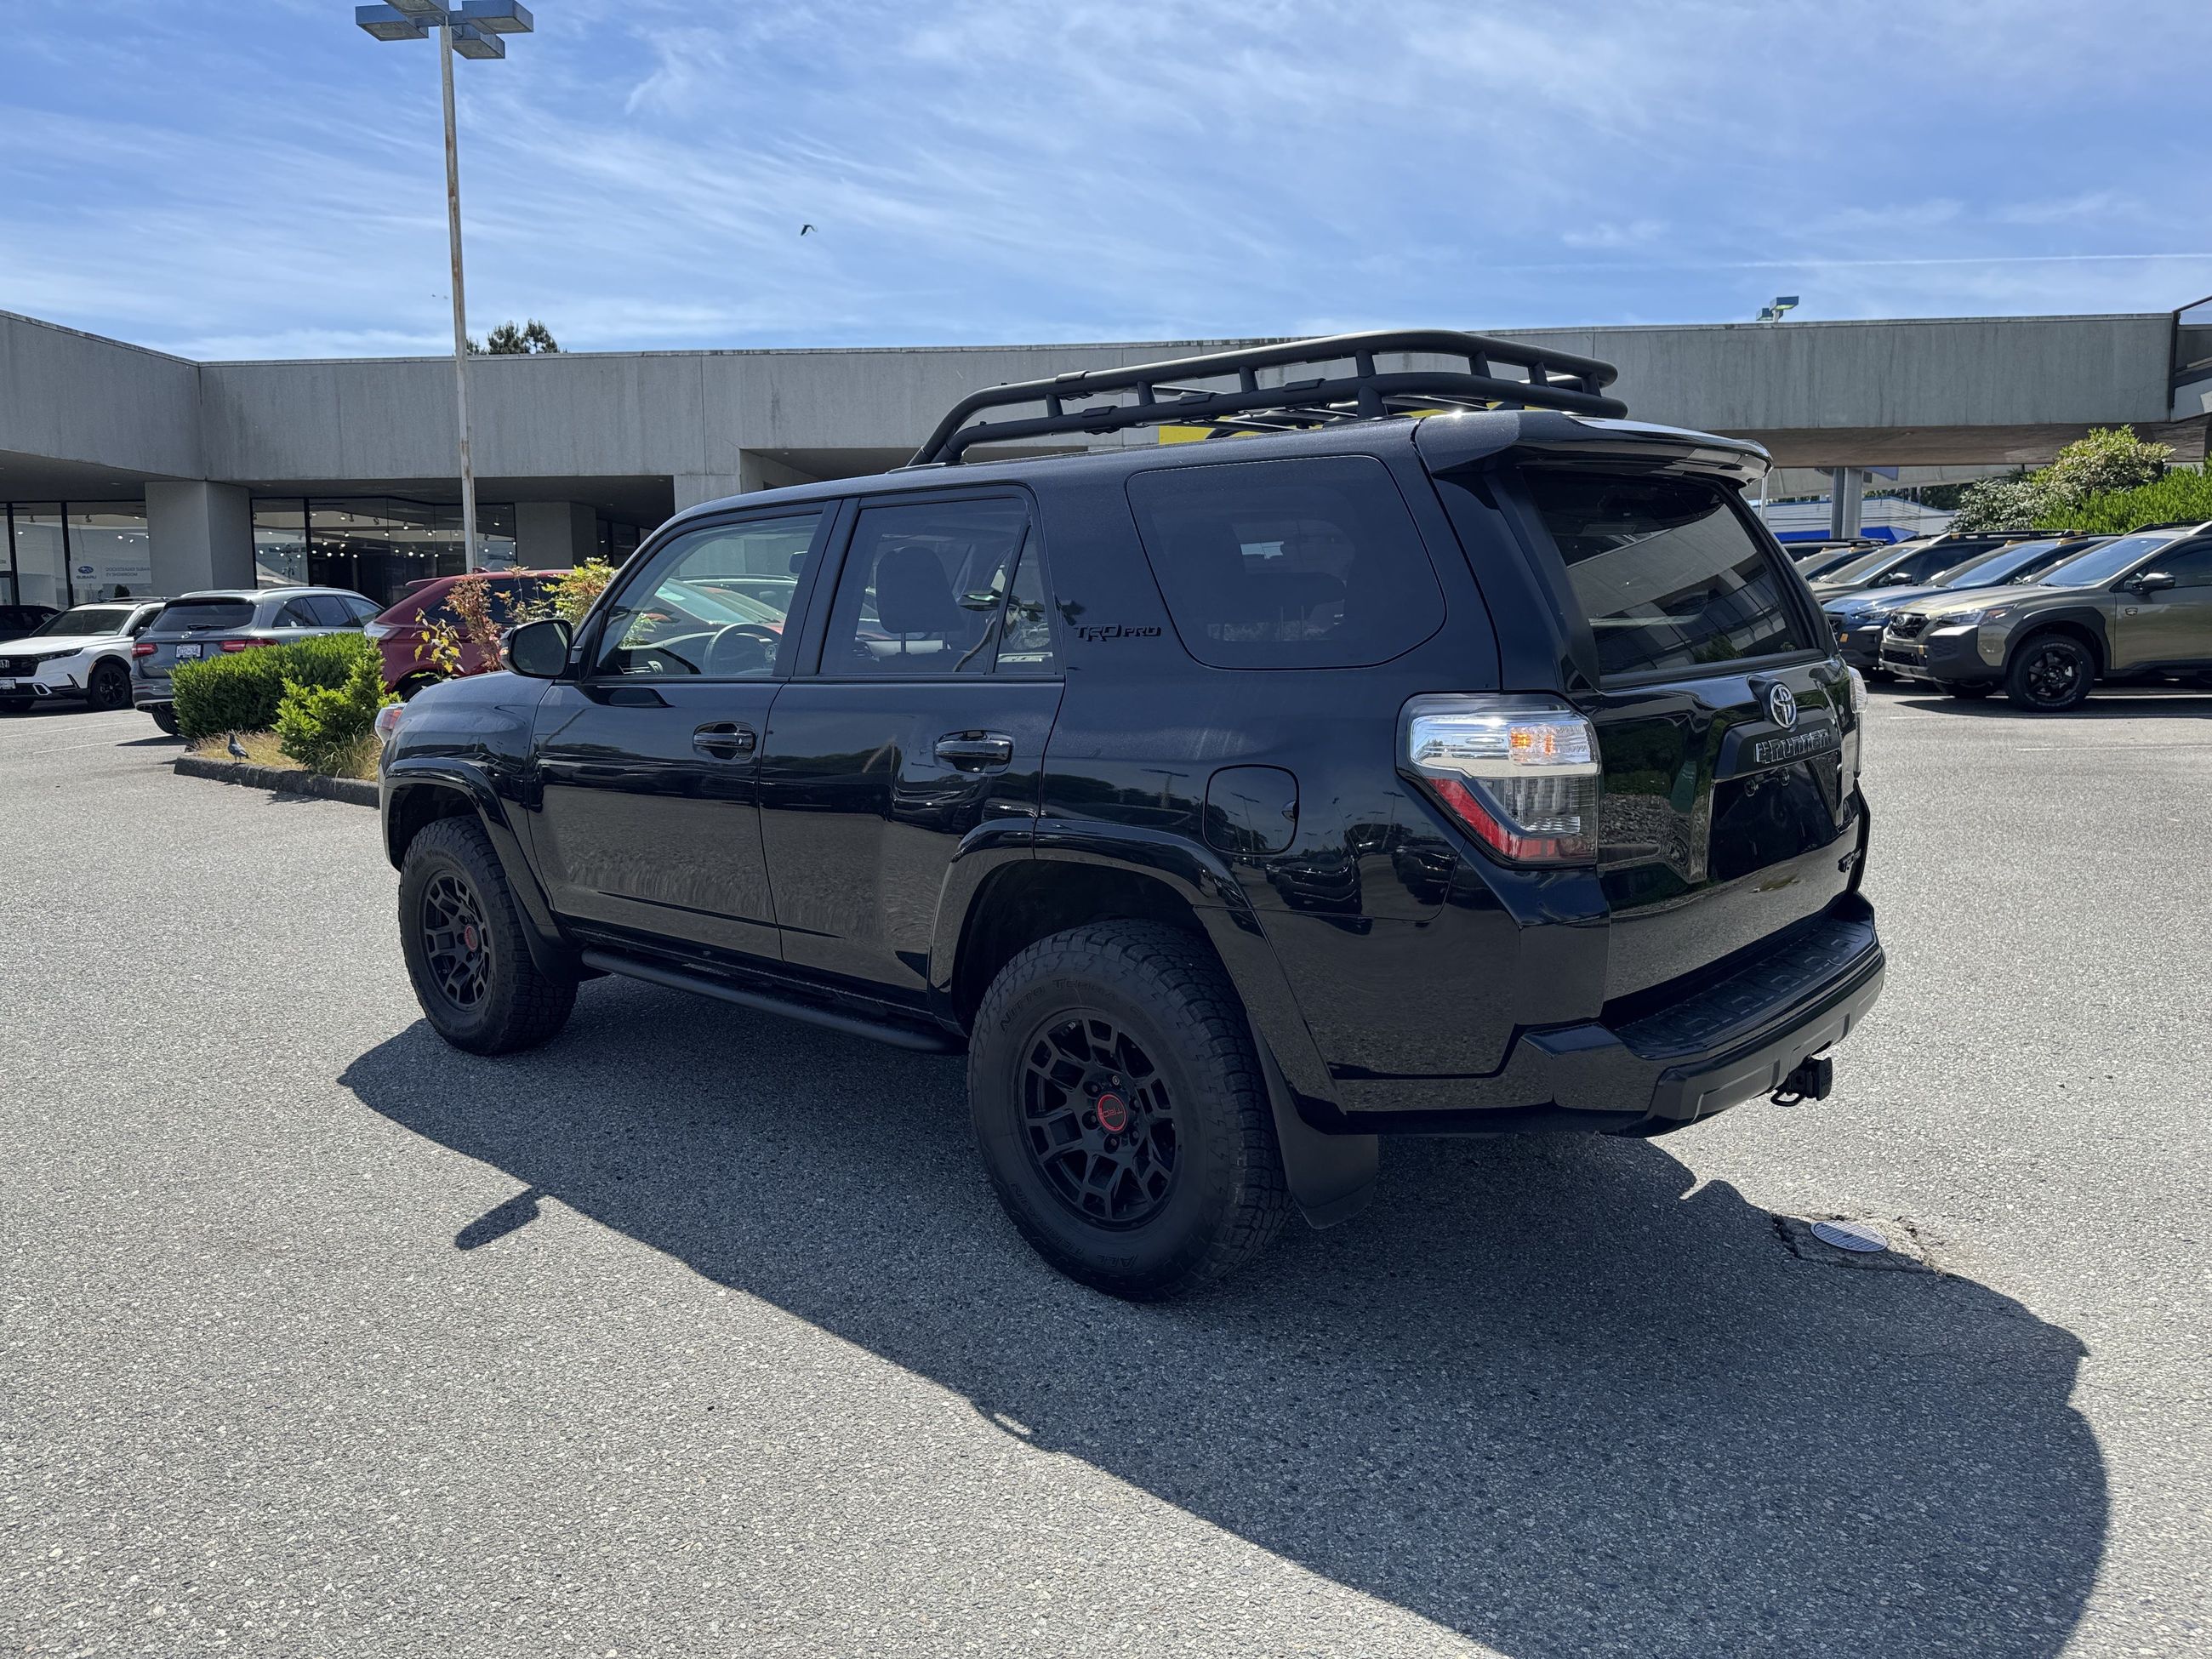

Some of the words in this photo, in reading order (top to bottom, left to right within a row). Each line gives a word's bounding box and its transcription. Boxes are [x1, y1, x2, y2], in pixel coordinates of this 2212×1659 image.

[1073, 624, 1122, 642] TRD
[1123, 626, 1161, 637] PRO
[1755, 728, 1832, 764] 4RUNNER
[1000, 986, 1046, 1034] NITTO
[1103, 1107, 1123, 1118] TRD
